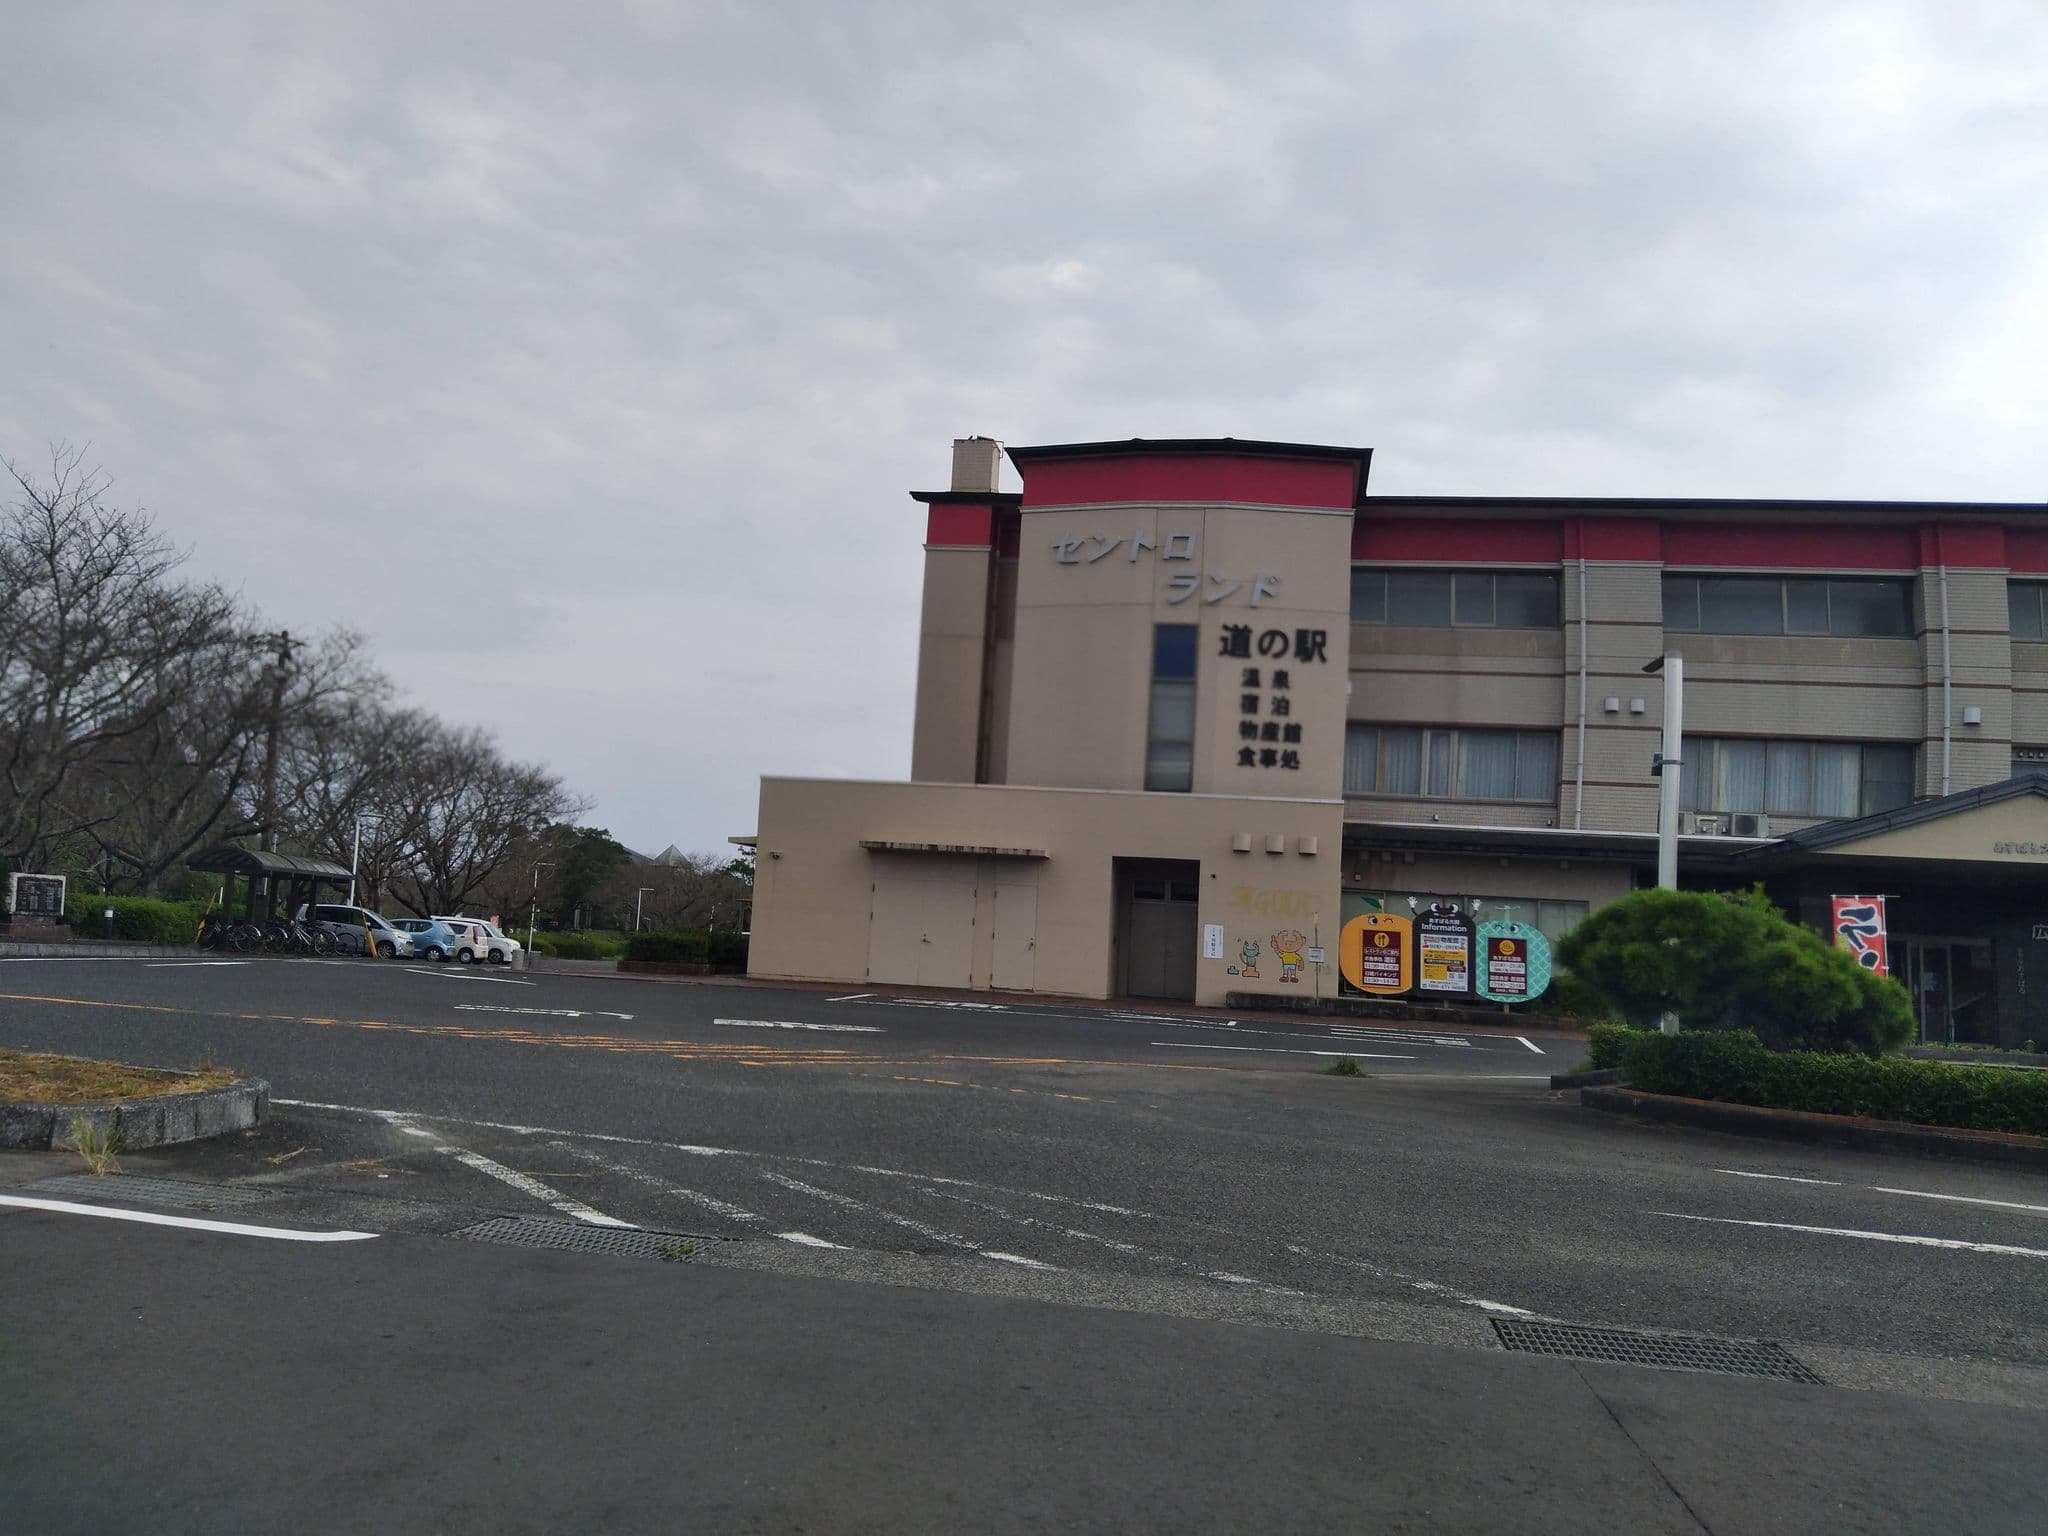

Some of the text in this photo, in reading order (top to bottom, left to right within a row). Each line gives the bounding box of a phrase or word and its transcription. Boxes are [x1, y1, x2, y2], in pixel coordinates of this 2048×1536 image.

[1051, 527, 1197, 564] セントロ
[1167, 569, 1282, 608] ランド
[1218, 624, 1328, 664] 道の駅
[1241, 668, 1291, 690] 温泉
[1239, 693, 1291, 716] 宿泊
[1238, 720, 1303, 744] 物産館
[1236, 745, 1301, 770] 食事処
[1421, 923, 1467, 932] Information
